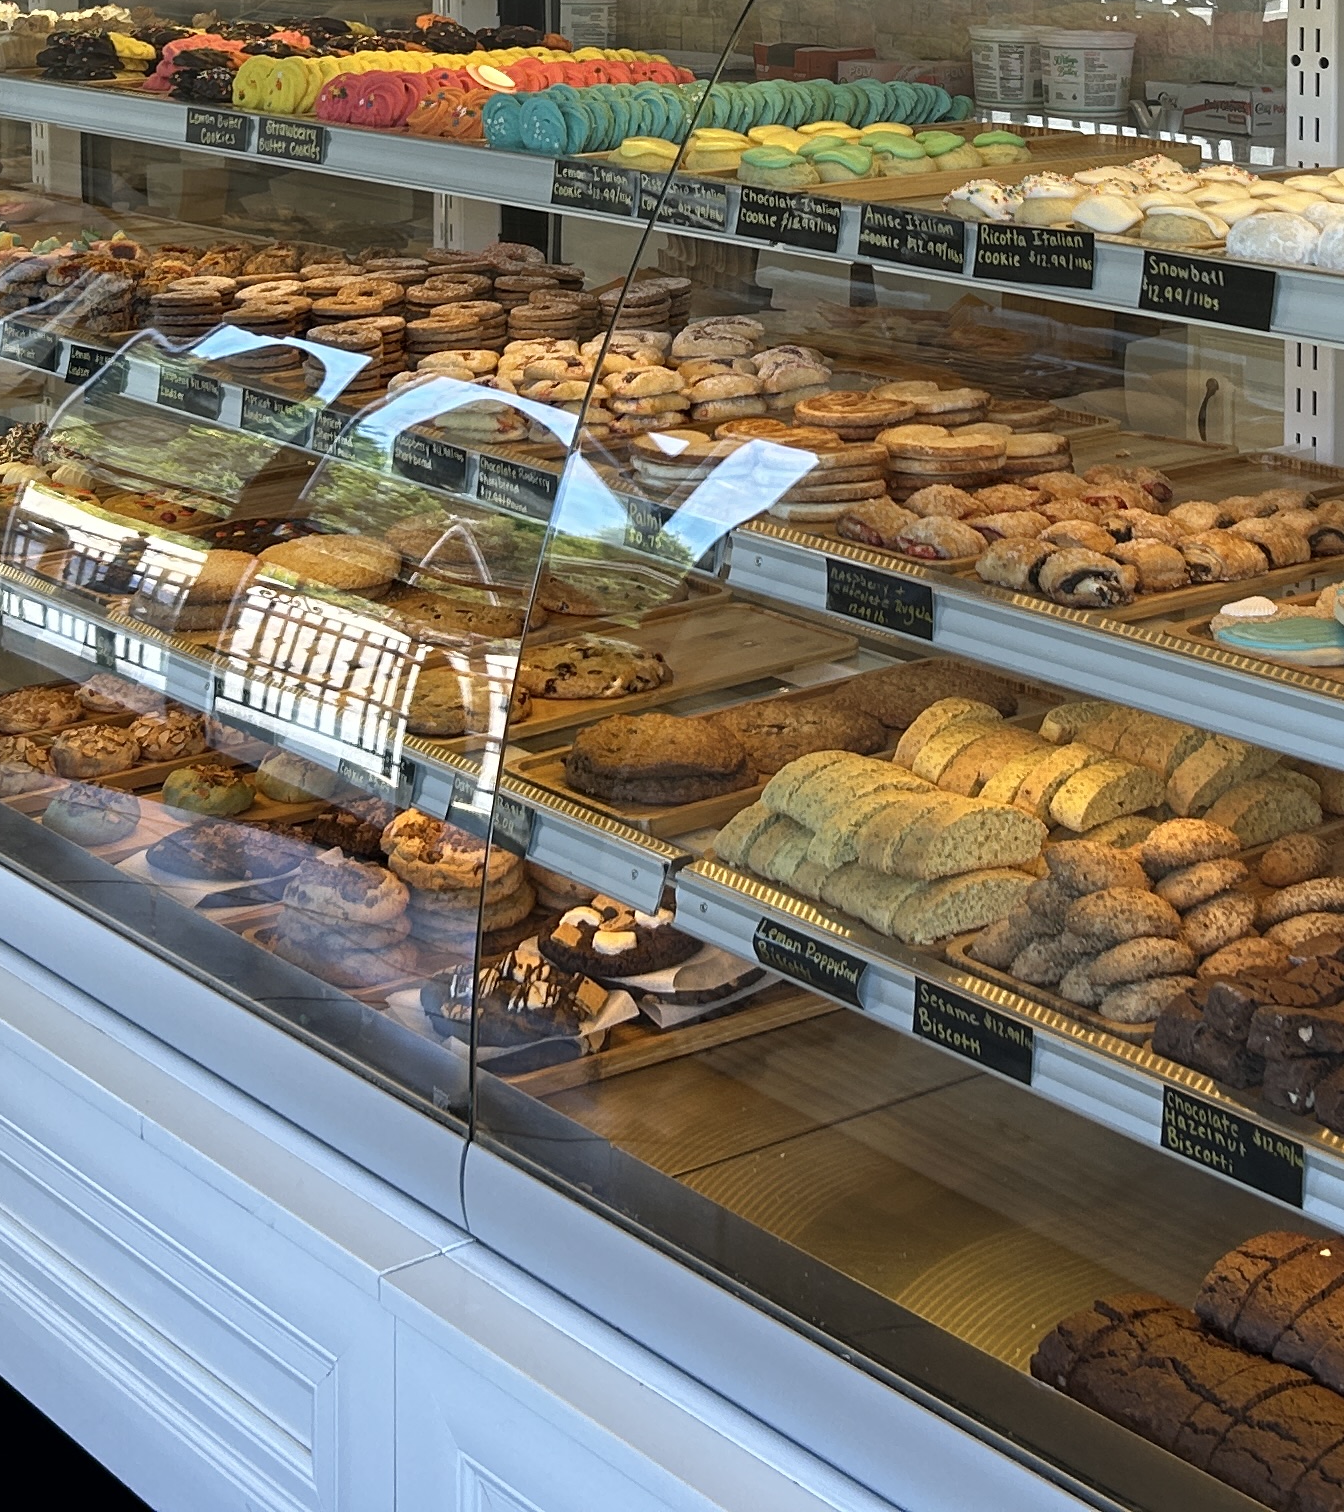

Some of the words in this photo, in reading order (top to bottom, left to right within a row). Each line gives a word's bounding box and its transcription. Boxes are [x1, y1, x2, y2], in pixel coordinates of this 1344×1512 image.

[200, 127, 236, 145] Cookies
[742, 188, 797, 208] Chocolate
[801, 197, 841, 218] Italian
[864, 205, 901, 230] Anise
[906, 213, 954, 237] Italian
[981, 224, 1027, 248] Ricotta
[1032, 230, 1084, 249] Italian
[1149, 255, 1225, 287] Snowball
[480, 457, 517, 479] Chocolate
[920, 983, 980, 1026] Sesame
[1166, 1091, 1240, 1138] Chocolate
[1164, 1107, 1248, 1158] Hazelnut
[1167, 1126, 1234, 1174] Biscotti
